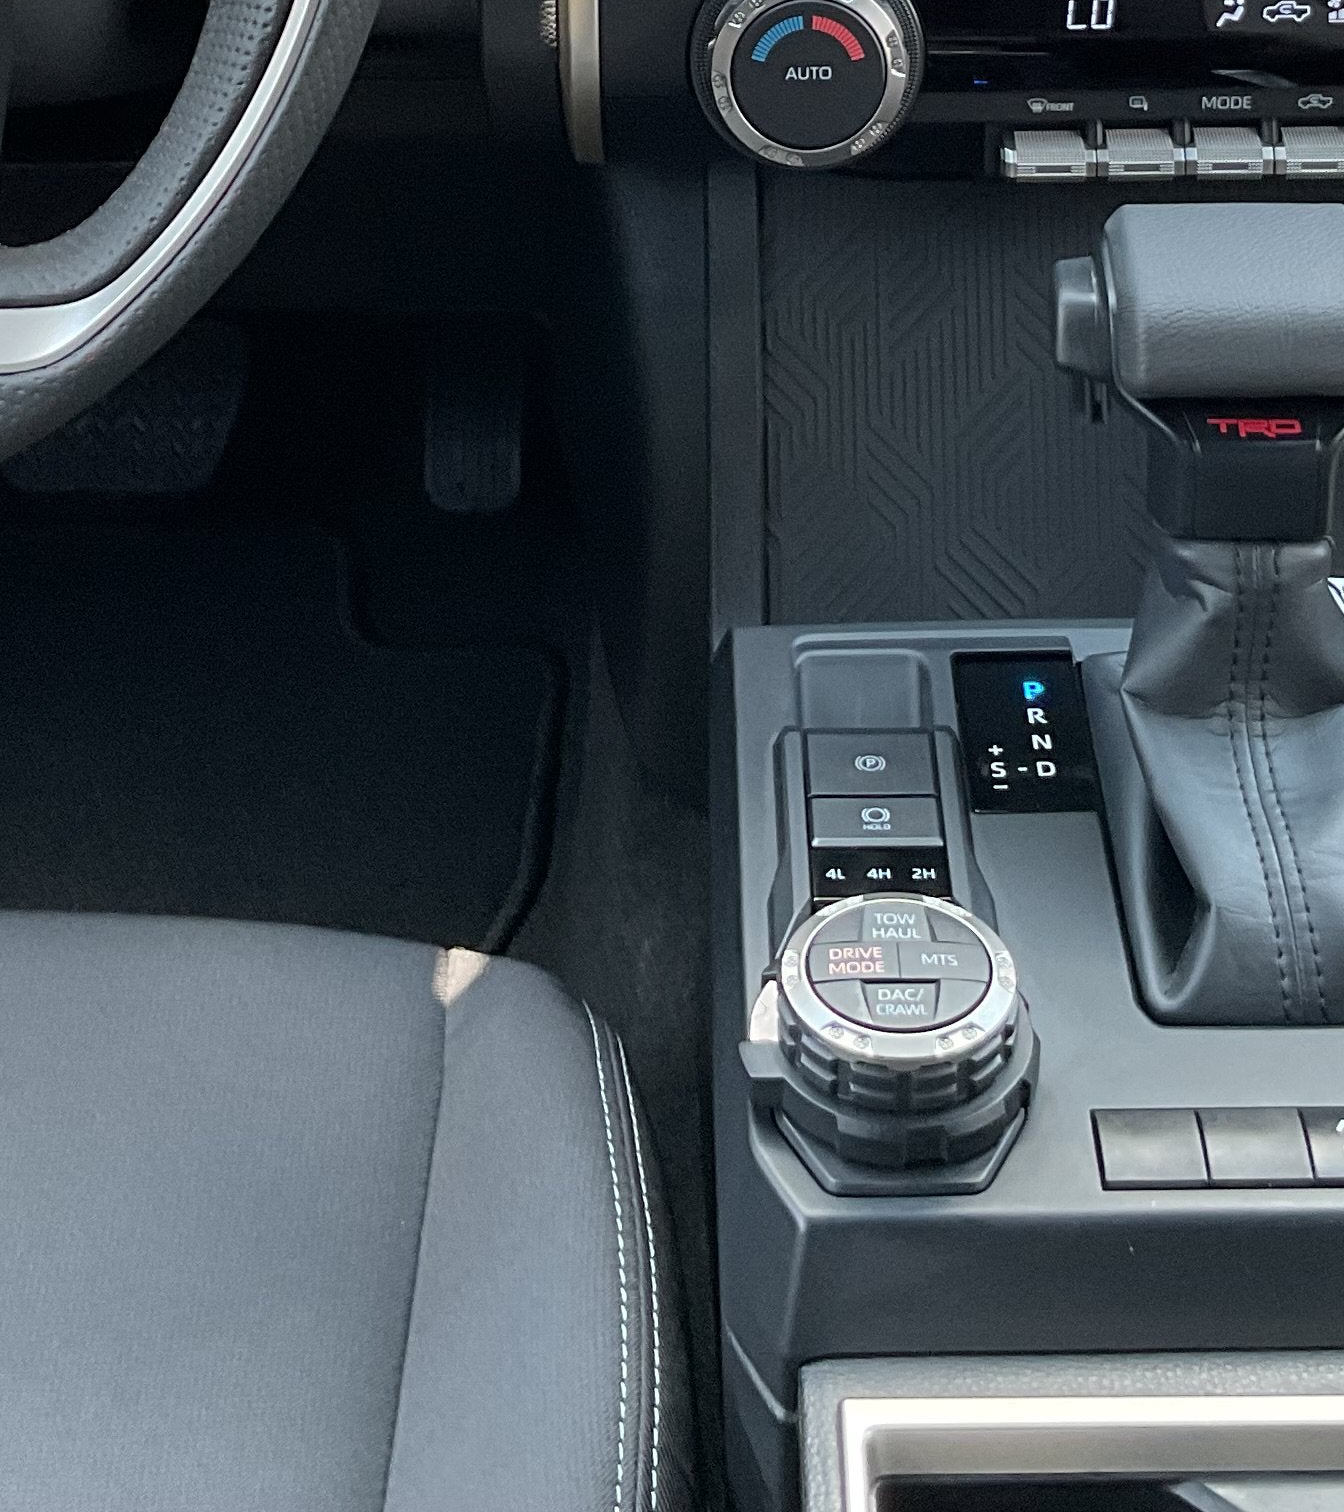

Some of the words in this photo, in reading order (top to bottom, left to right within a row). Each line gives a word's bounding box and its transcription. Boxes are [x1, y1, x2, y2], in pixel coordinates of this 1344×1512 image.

[785, 66, 833, 81] AUTO
[1046, 102, 1074, 111] FRONT
[1201, 95, 1253, 110] MODE
[1206, 416, 1303, 439] TRD
[1023, 681, 1046, 700] P
[1027, 707, 1048, 724] R
[1031, 734, 1053, 750] N
[990, 761, 1007, 778] S
[1036, 761, 1057, 777] D
[862, 823, 892, 831] HOLD
[825, 868, 846, 880] 4L
[866, 868, 892, 880] 4H
[911, 867, 937, 880] 2H
[873, 912, 916, 925] TOW
[871, 926, 922, 939] HAUL
[828, 946, 884, 960] DRIVE
[920, 953, 959, 967] MTS
[828, 960, 886, 975] MODE
[877, 988, 925, 1002] DAC/
[875, 1003, 929, 1017] CRAWL
